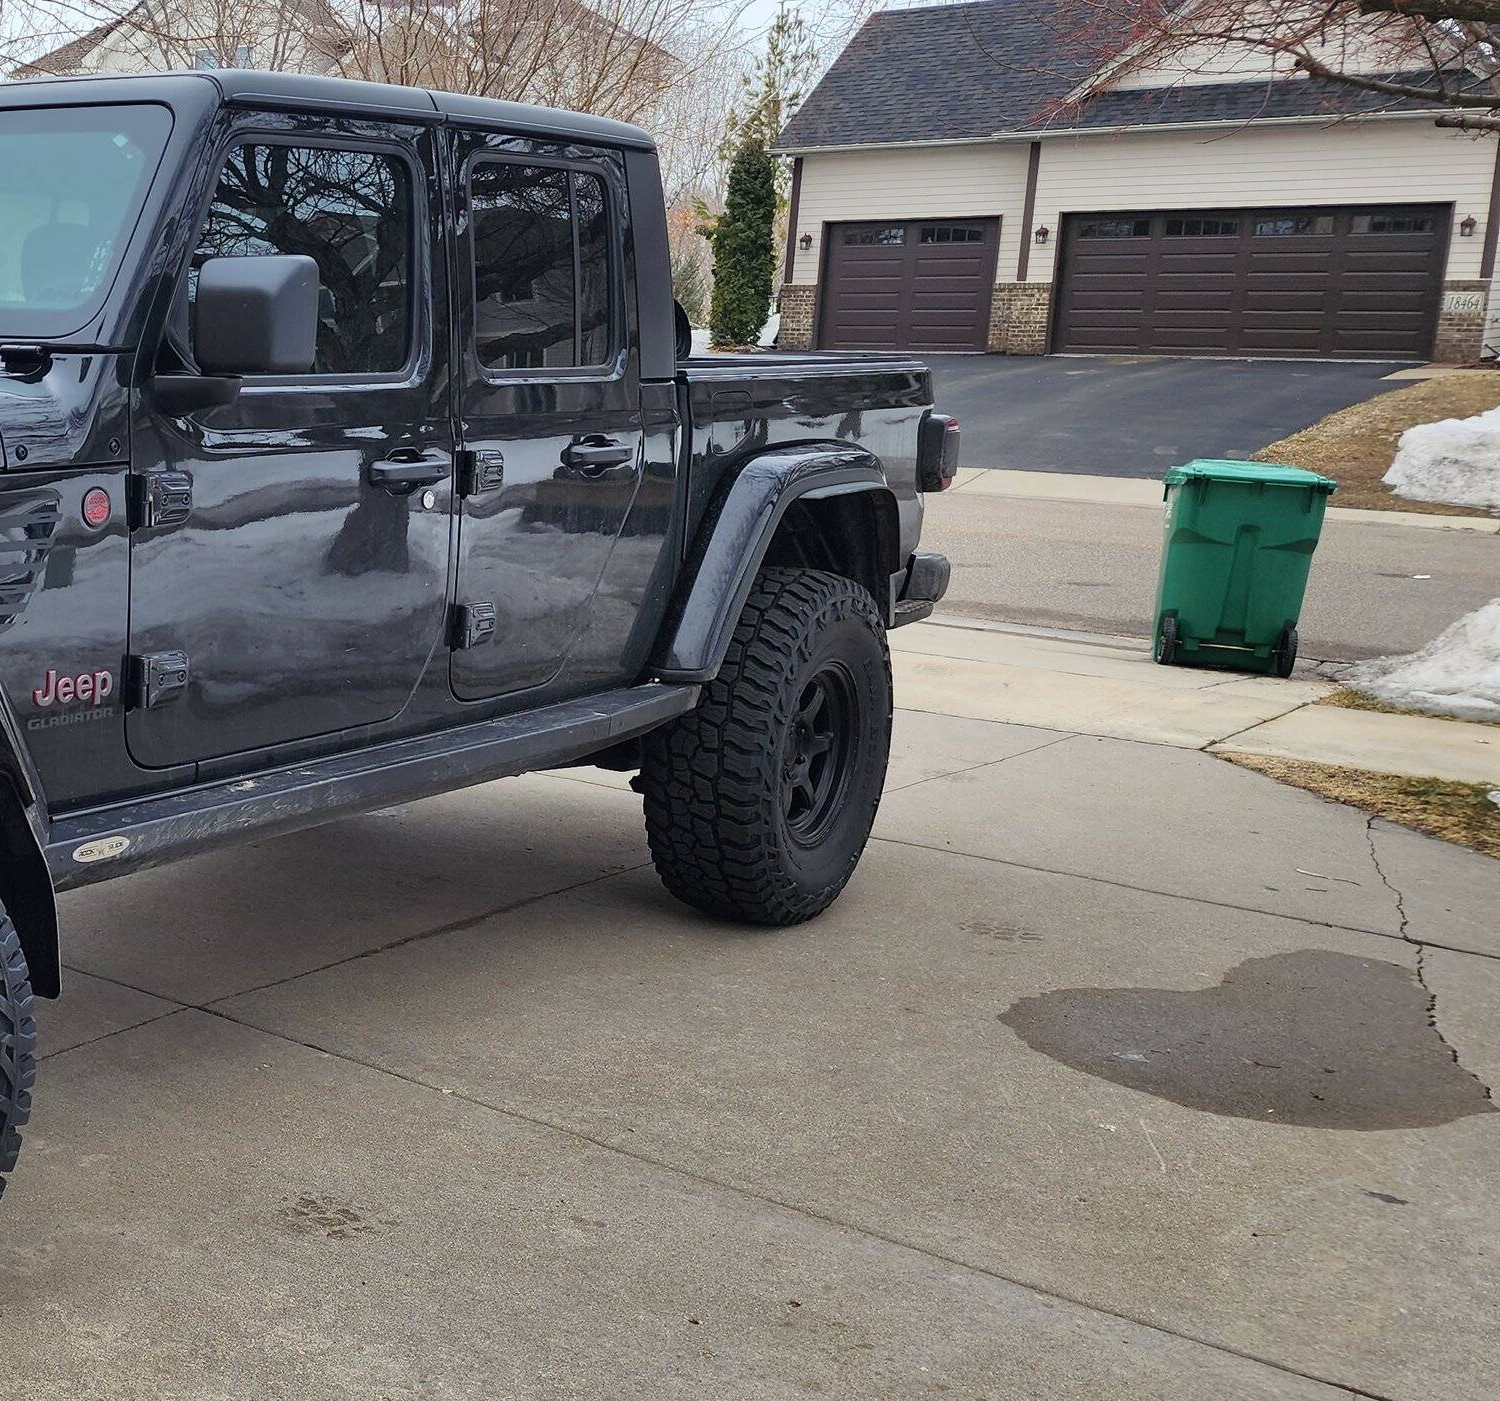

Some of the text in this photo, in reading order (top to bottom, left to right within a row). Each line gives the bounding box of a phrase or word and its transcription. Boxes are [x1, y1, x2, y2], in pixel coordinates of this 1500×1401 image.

[1448, 295, 1482, 309] 18464
[32, 669, 113, 707] Jeep
[27, 707, 114, 730] GLADIATOR
